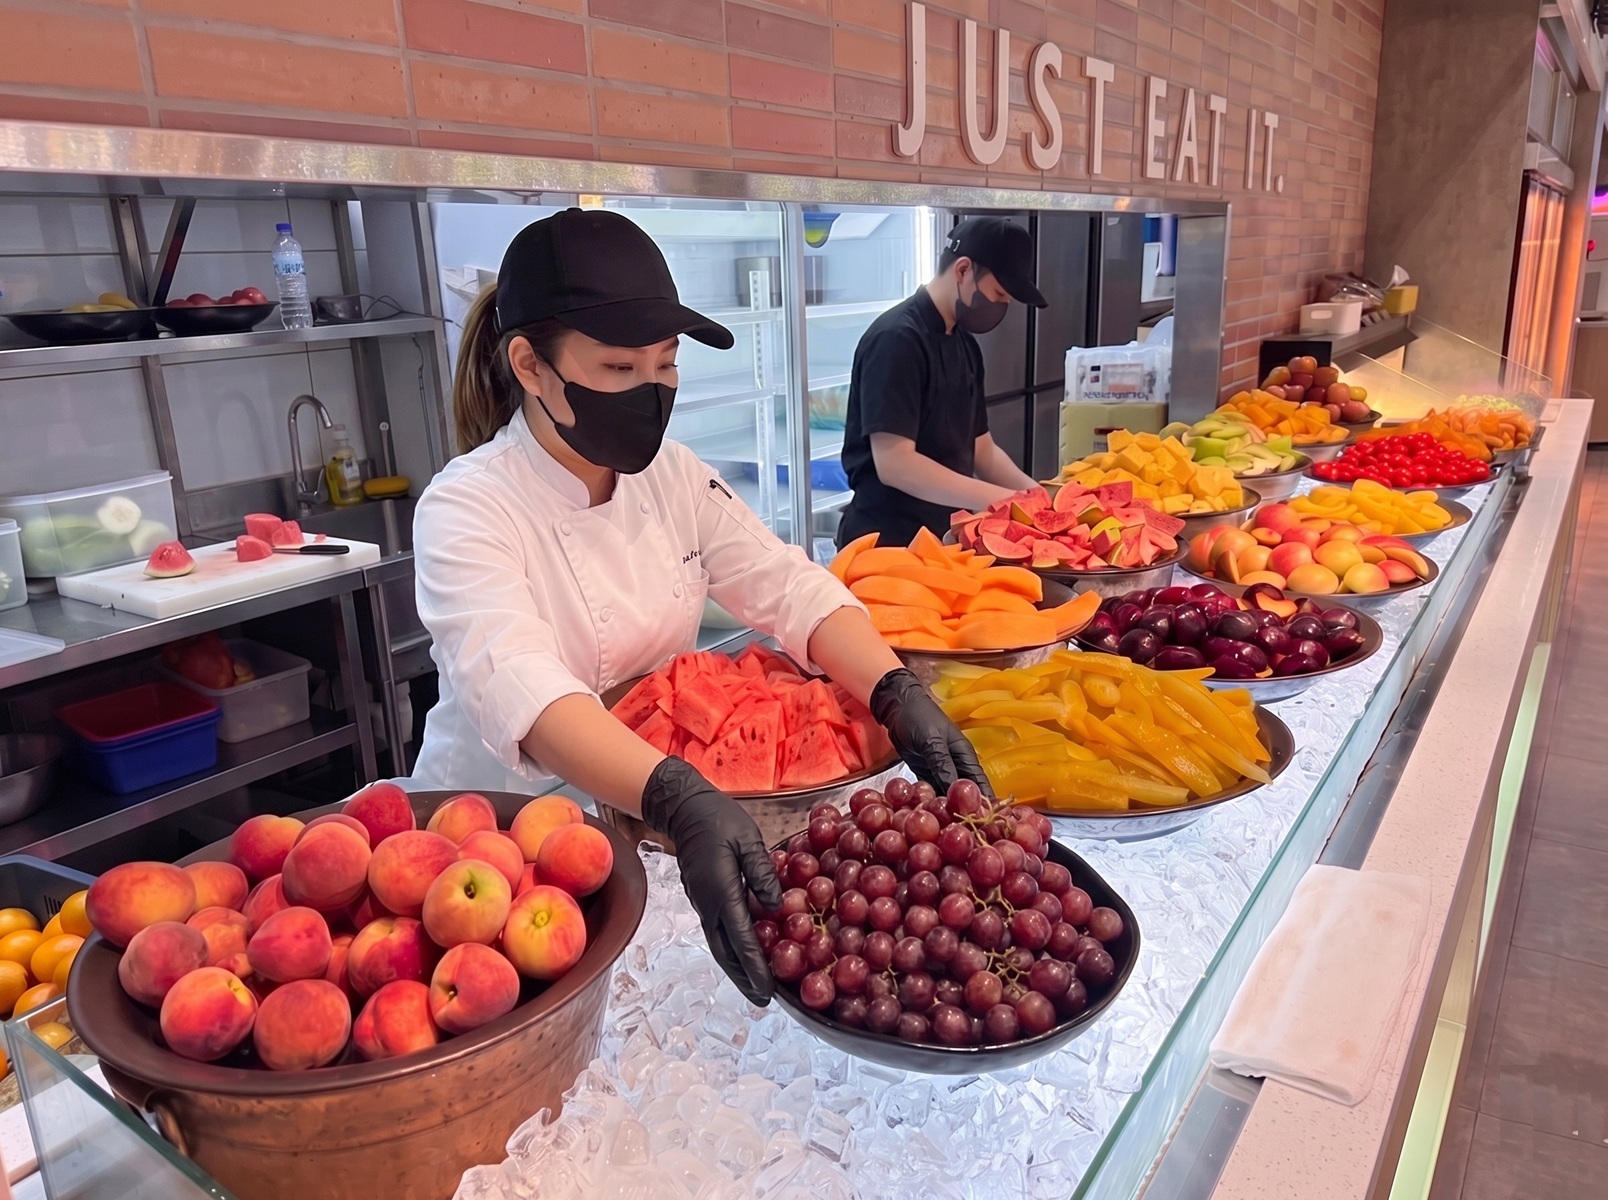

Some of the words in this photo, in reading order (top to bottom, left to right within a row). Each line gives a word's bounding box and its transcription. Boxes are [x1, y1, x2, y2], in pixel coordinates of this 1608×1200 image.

[892, 2, 1115, 175] JUST
[1143, 75, 1227, 187] EAT
[1245, 108, 1285, 194] IT.
